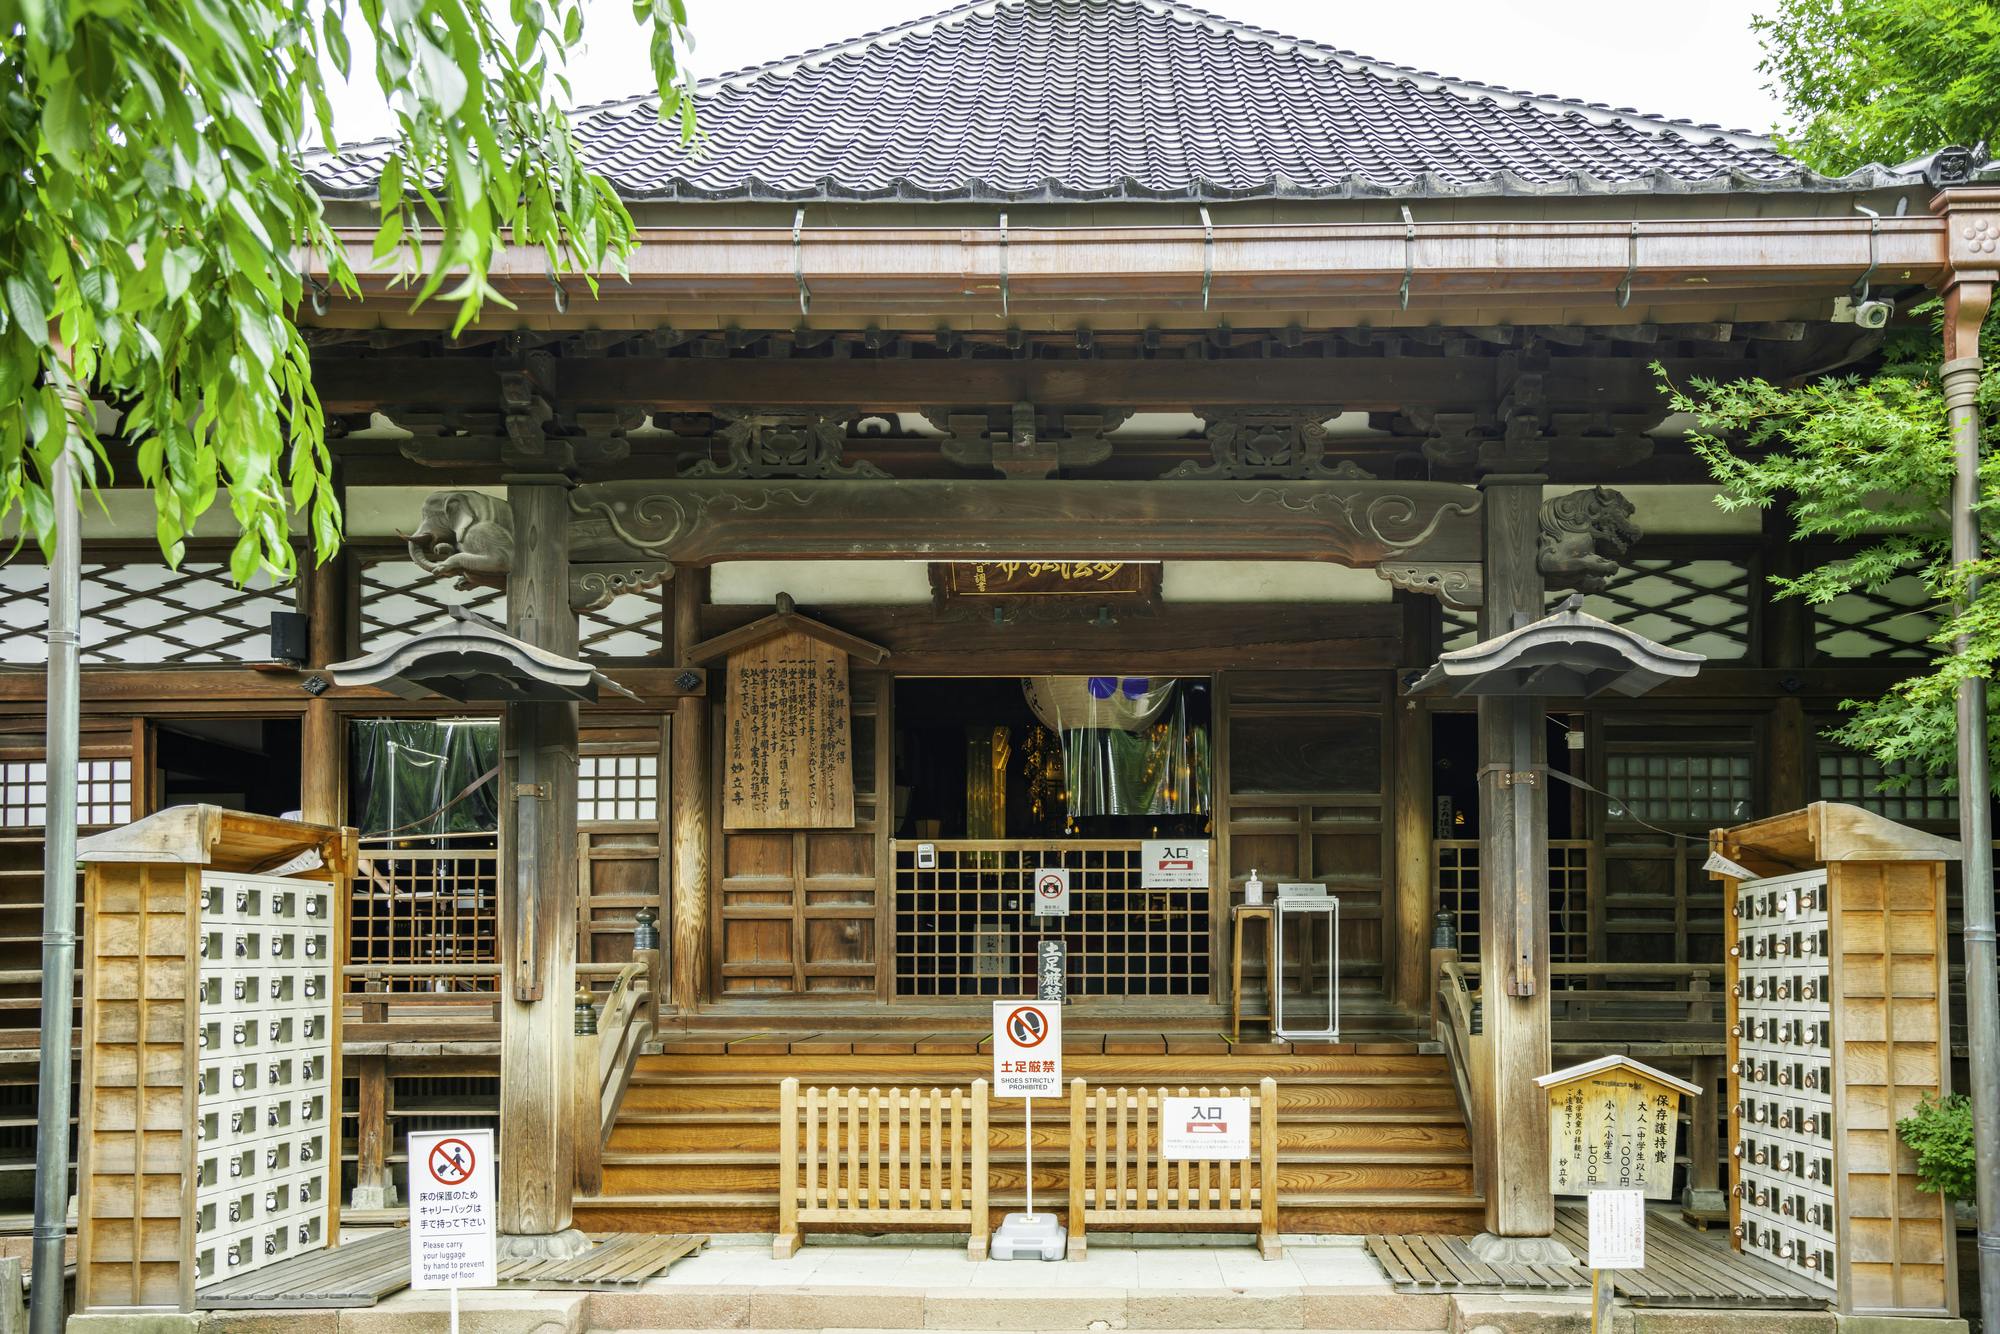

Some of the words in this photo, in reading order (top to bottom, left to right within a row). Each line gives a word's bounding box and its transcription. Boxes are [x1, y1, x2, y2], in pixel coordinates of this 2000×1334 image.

[731, 762, 744, 805] 妙立寺
[1163, 847, 1189, 859] 入口
[1042, 942, 1063, 1000] 土足厳禁
[1001, 1060, 1055, 1073] 土足厳禁
[1191, 1106, 1222, 1120] 入口
[1564, 1088, 1573, 1136] ご遠慮下さい
[1654, 1094, 1669, 1163] 保存護持費
[1559, 1158, 1568, 1186] 妙立寺
[419, 1191, 478, 1201] 床の保護のため
[420, 1204, 481, 1215] キャリーバッグは
[420, 1218, 486, 1229] 手で持って下さい
[423, 1241, 445, 1249] Please
[446, 1241, 463, 1250] carry
[423, 1253, 438, 1261] your
[439, 1252, 466, 1260] luggage
[423, 1262, 431, 1270] by
[459, 1261, 484, 1270] prevent
[423, 1272, 449, 1281] damage
